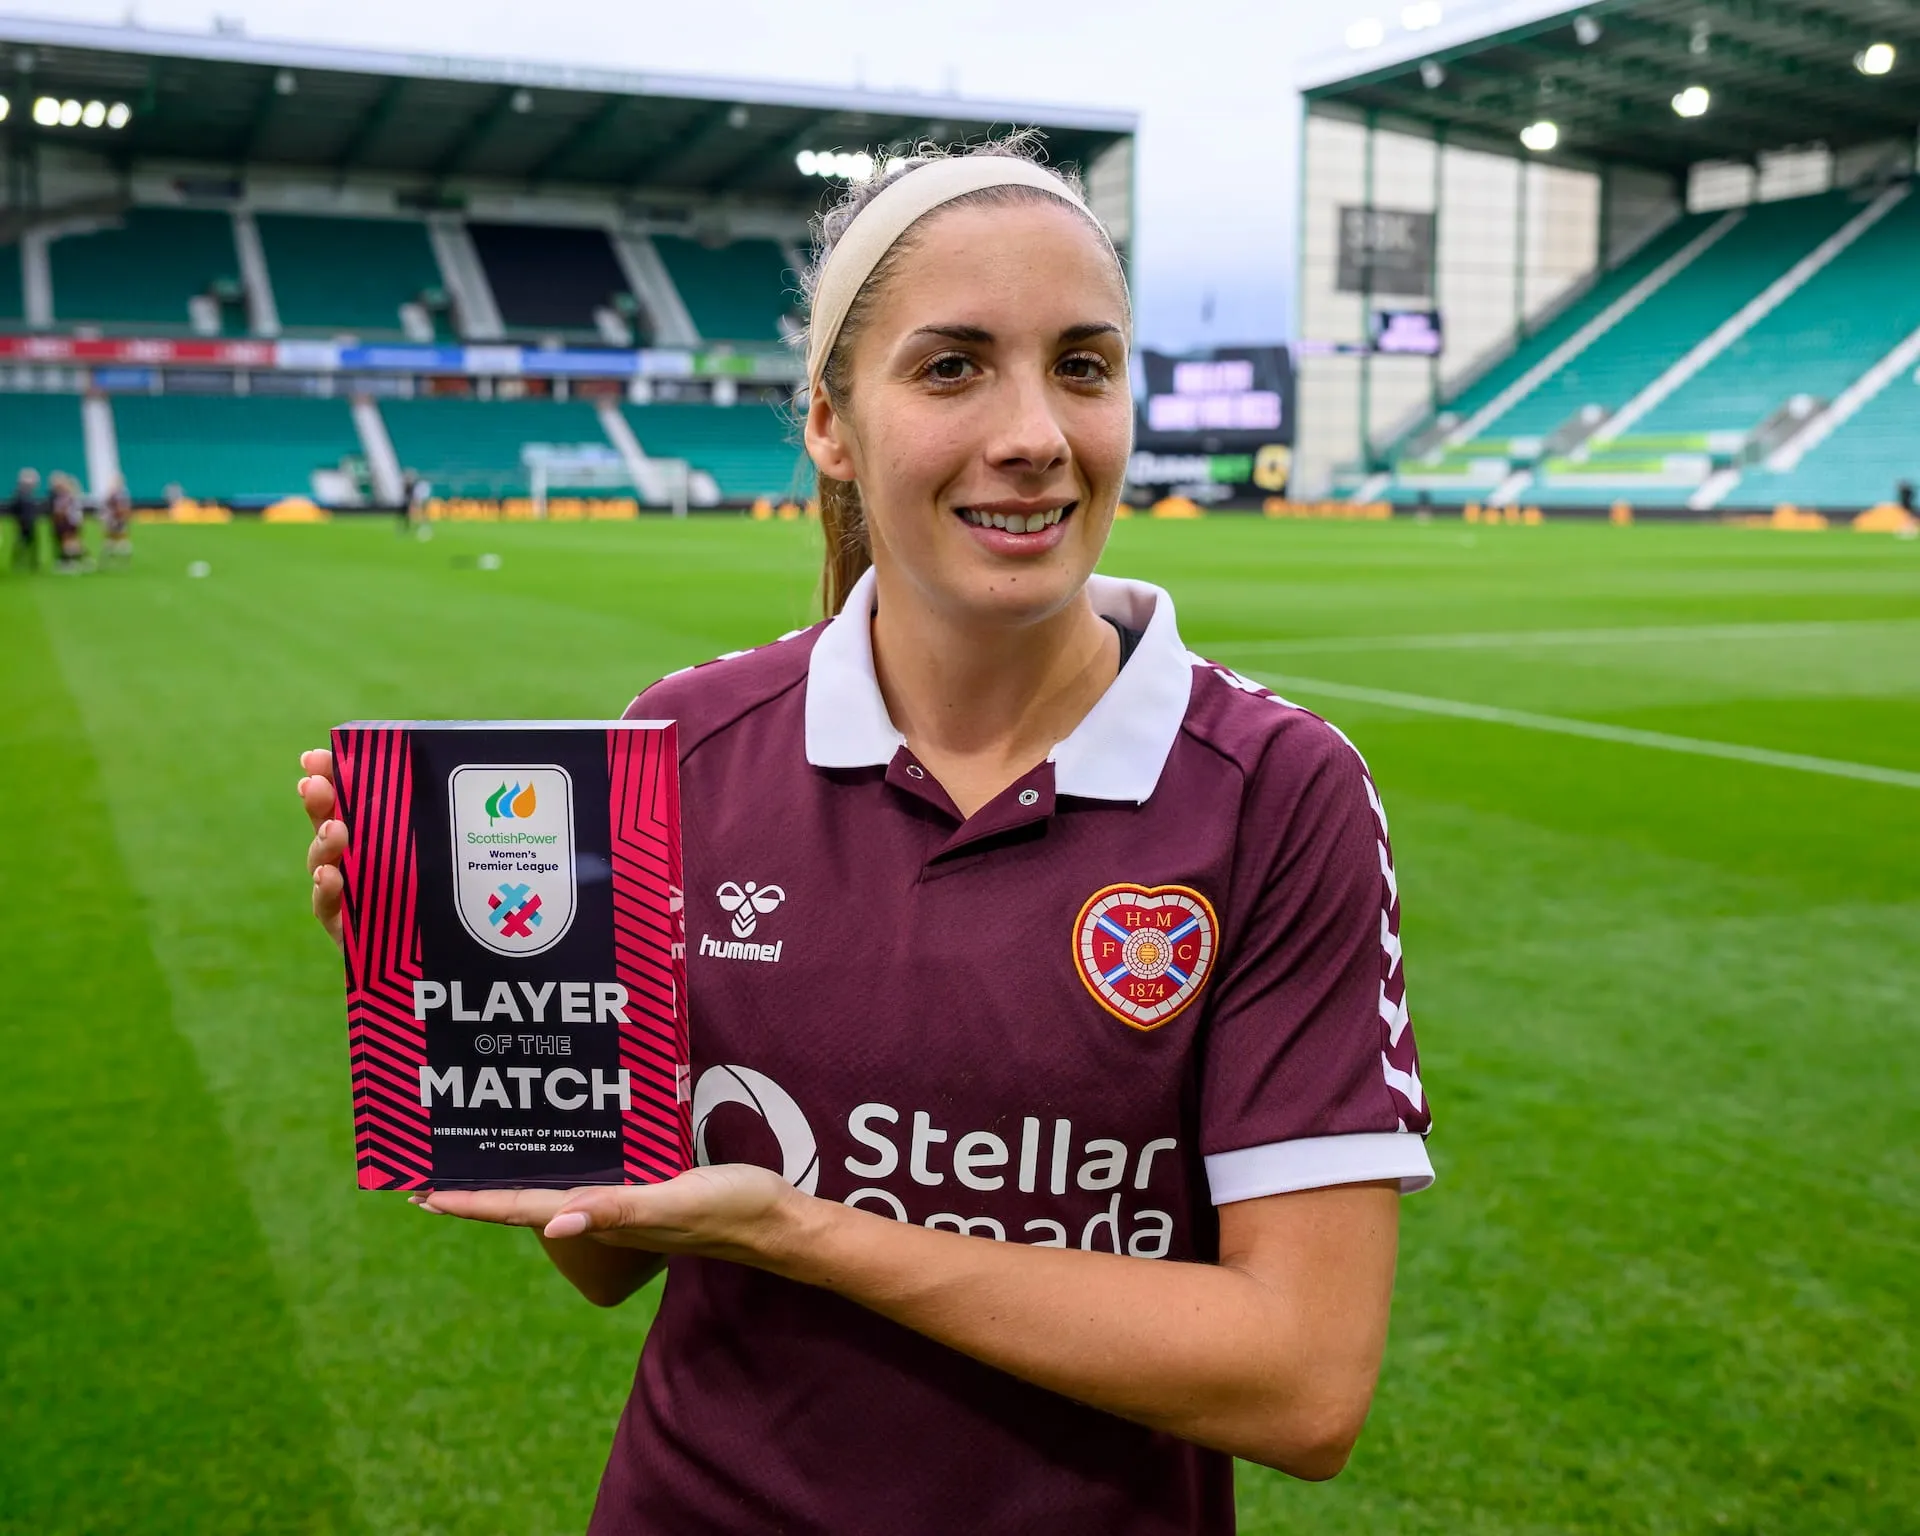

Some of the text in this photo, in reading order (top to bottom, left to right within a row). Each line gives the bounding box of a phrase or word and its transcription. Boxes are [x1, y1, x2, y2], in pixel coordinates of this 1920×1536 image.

[467, 832, 558, 844] ScottishPower
[468, 860, 559, 874] Premier League
[699, 933, 783, 963] hummel
[1102, 942, 1192, 960] F C
[1129, 983, 1164, 998] 1874
[413, 981, 632, 1023] PLAYER
[474, 1034, 572, 1056] OF THE
[419, 1066, 632, 1110] MATCH
[433, 1127, 617, 1139] HIBERNIAN V HEART OF MIDLOTHIAN
[478, 1141, 575, 1152] 4TH OCTOBER 2026
[844, 1103, 1177, 1195] Stellar
